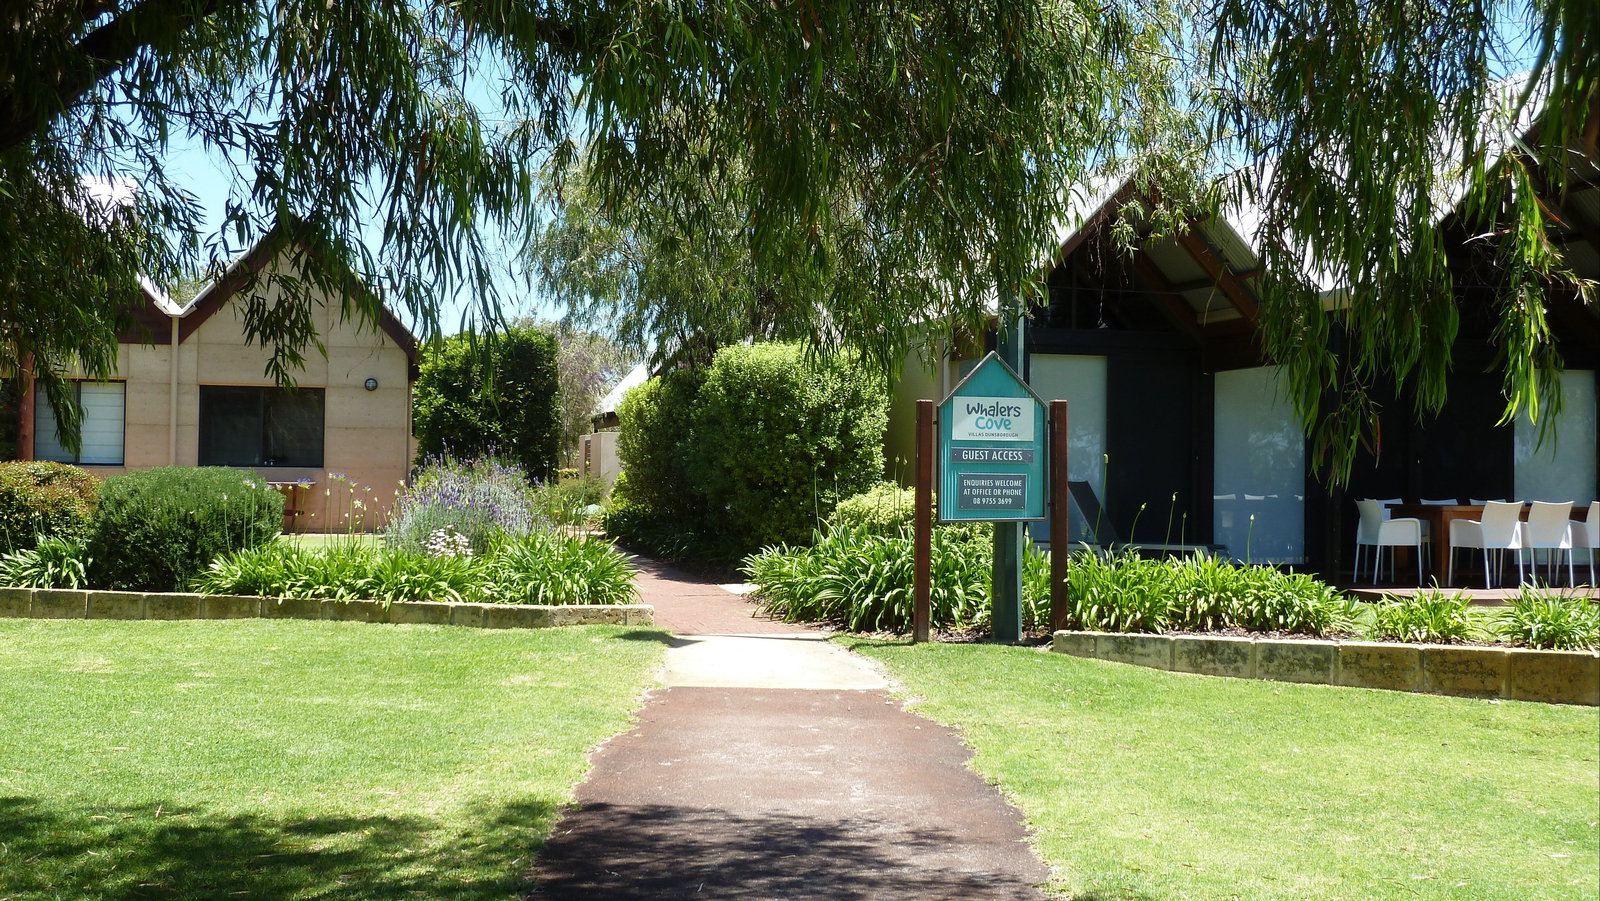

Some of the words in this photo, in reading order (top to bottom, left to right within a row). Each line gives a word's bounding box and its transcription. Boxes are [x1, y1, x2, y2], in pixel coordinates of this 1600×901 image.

[966, 401, 1021, 417] Whalers
[975, 416, 1012, 430] Cove
[962, 450, 989, 460] GUEST
[992, 450, 1023, 461] ACCESS
[963, 479, 993, 487] ENQUIRIES
[972, 497, 980, 505] 08
